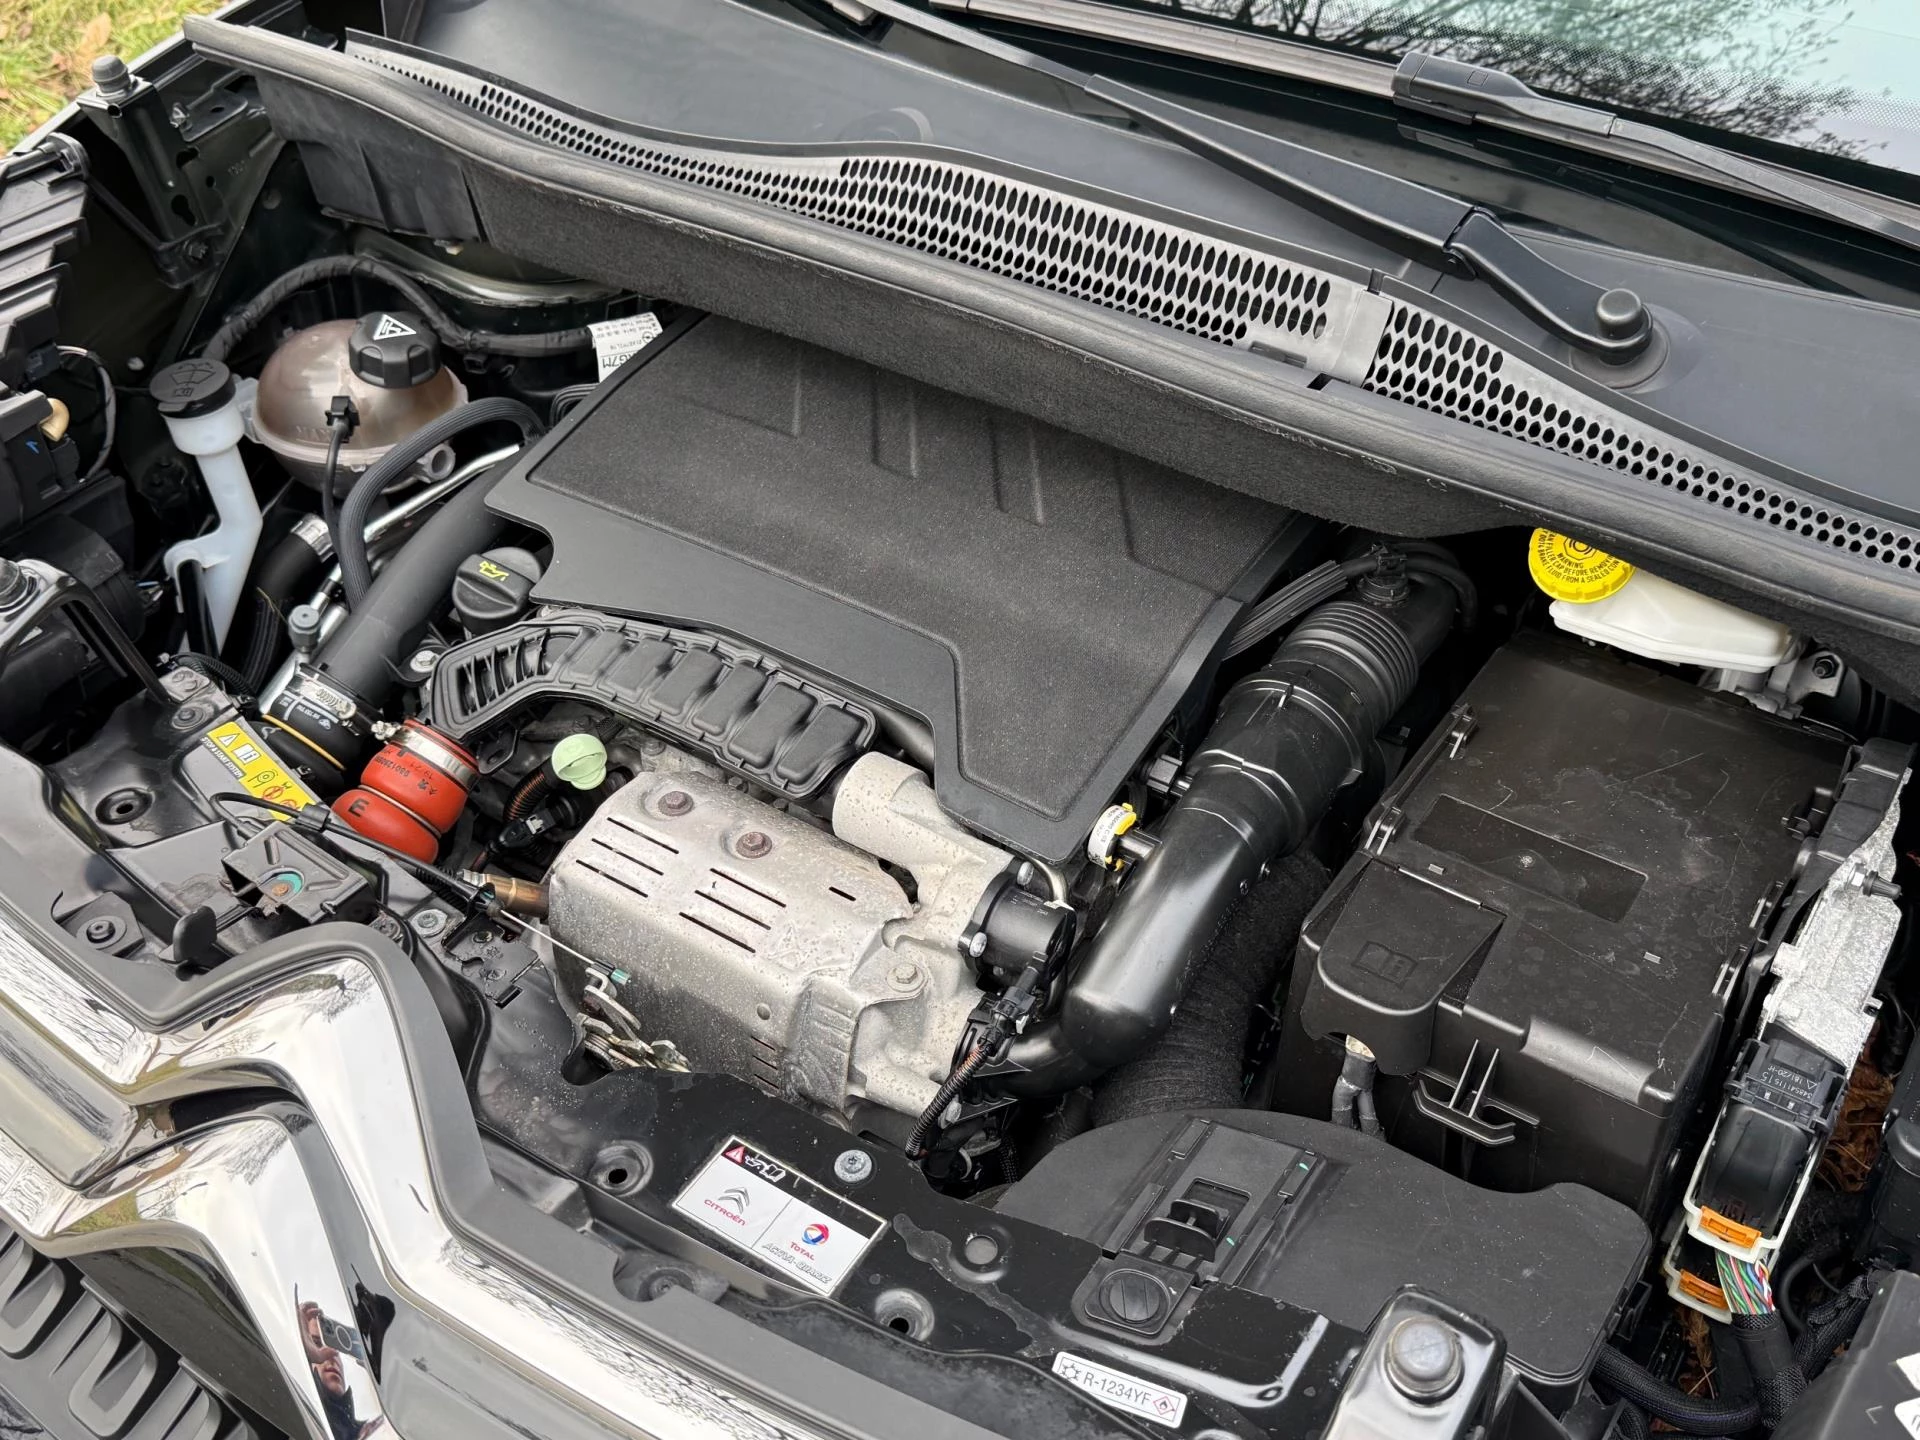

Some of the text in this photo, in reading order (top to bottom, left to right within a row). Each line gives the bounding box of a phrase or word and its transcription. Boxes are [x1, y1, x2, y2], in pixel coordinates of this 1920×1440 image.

[602, 353, 637, 369] G7M
[1552, 560, 1566, 570] CAP
[1563, 567, 1589, 577] BEFORE
[1557, 552, 1584, 569] WARNING
[1546, 565, 1562, 579] FLUID
[1562, 574, 1580, 583] FROM
[1586, 569, 1610, 583] SEALED
[199, 734, 215, 749] STOP
[213, 748, 230, 764] START
[348, 798, 369, 817] E
[704, 1199, 747, 1226] CITROËN
[790, 1241, 815, 1261] TOTAL
[1083, 1371, 1151, 1404] R-1234YF
